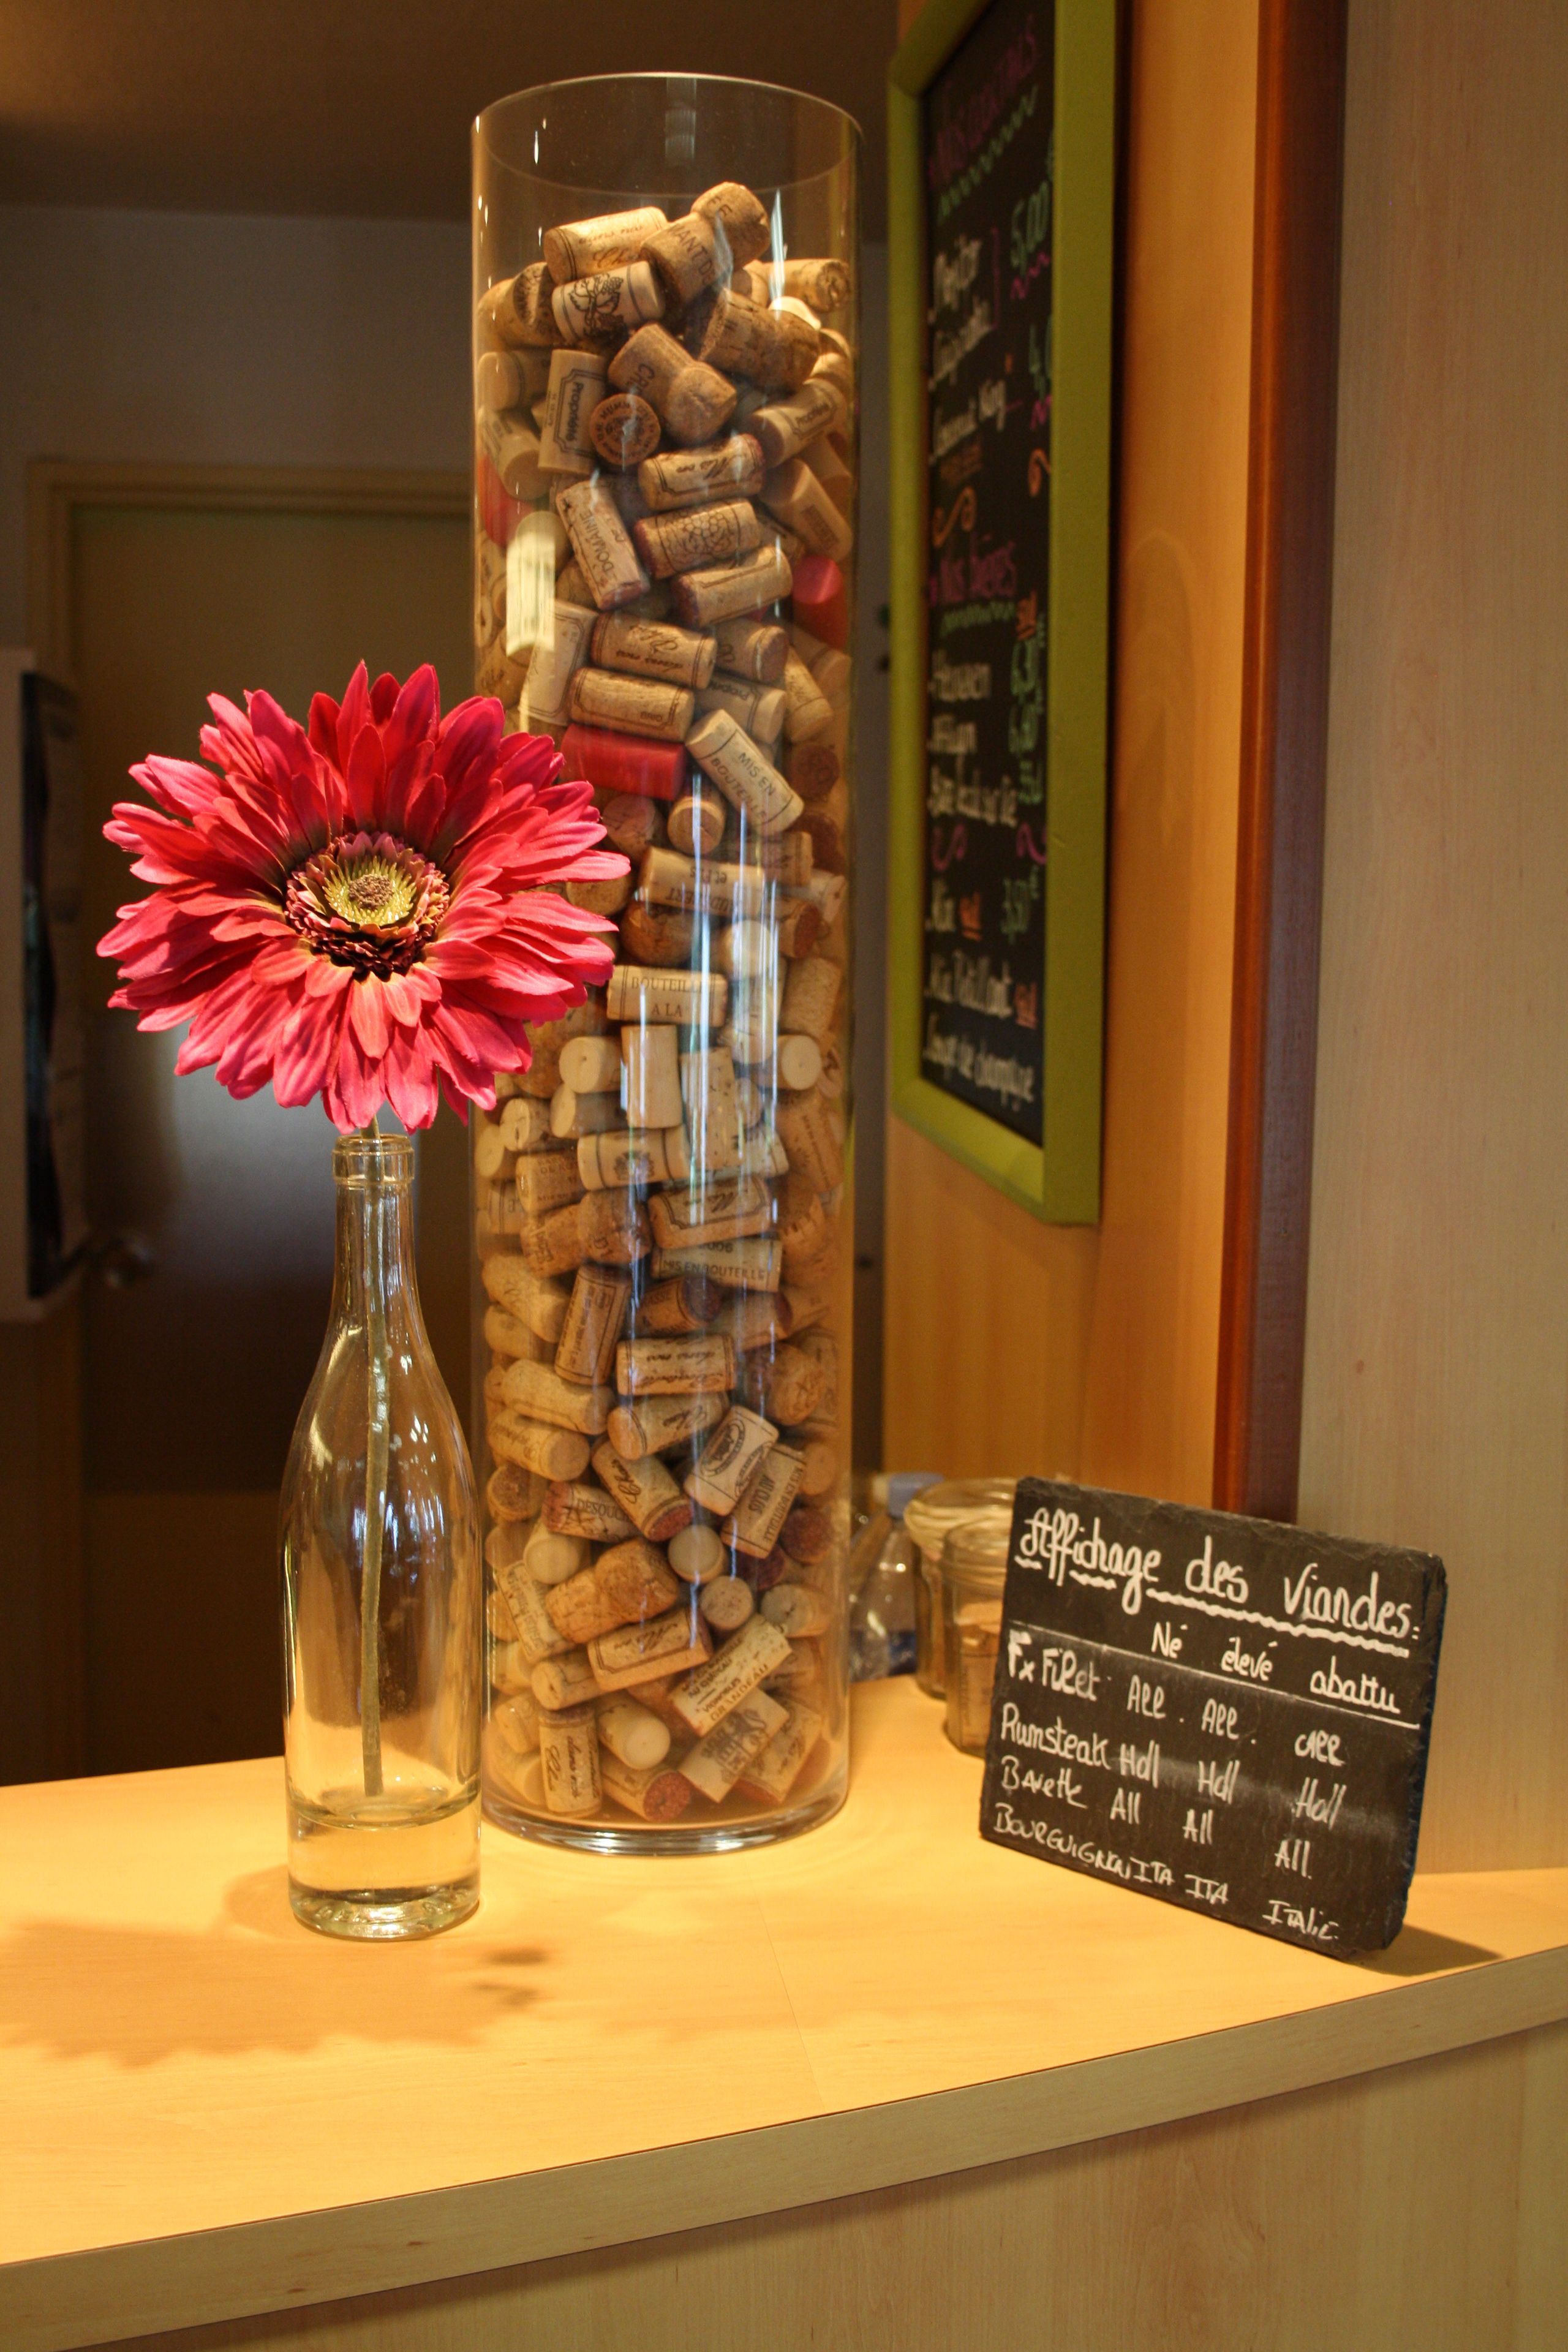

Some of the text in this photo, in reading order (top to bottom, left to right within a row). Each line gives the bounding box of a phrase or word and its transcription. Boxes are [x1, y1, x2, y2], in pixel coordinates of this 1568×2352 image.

[579, 507, 615, 574] DOMAINE
[738, 752, 776, 796] MIS EN
[1019, 1507, 1162, 1616] Affichage
[1185, 1534, 1249, 1604] des
[1042, 1648, 1101, 1702] Filet
[1150, 1621, 1401, 1715] Né élevé abattu
[1000, 1702, 1112, 1770] Rumsteak
[1109, 1787, 1142, 1825] All
[1182, 1807, 1215, 1846] All
[1183, 1873, 1230, 1905] ITA
